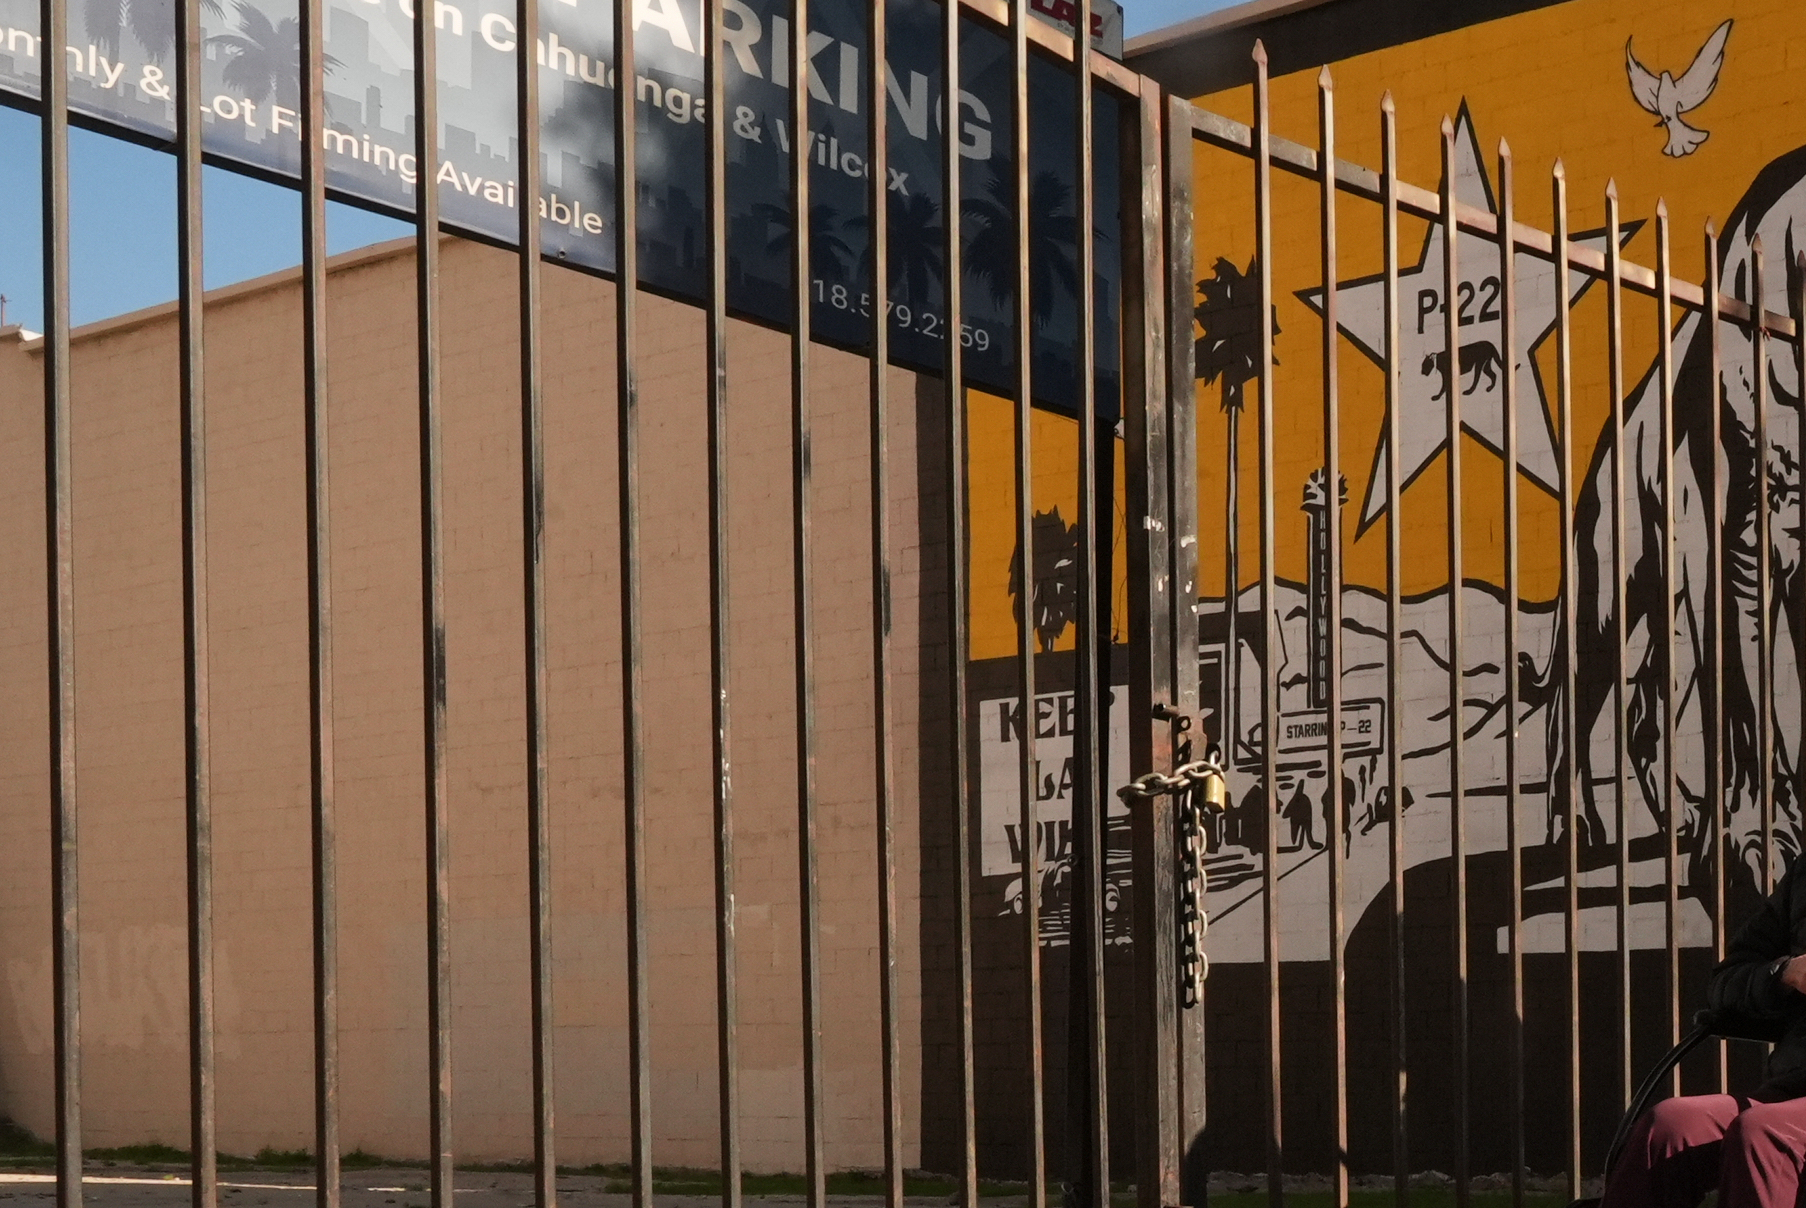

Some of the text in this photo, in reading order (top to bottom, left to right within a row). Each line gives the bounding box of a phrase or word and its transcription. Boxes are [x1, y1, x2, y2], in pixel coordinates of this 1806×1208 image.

[139, 64, 171, 100] &
[565, 0, 993, 161] ARKING
[732, 105, 763, 144] &
[1417, 275, 1500, 335] P-22
[1317, 510, 1328, 700] HOLLYWOOD
[1286, 721, 1329, 739] STARRIN
